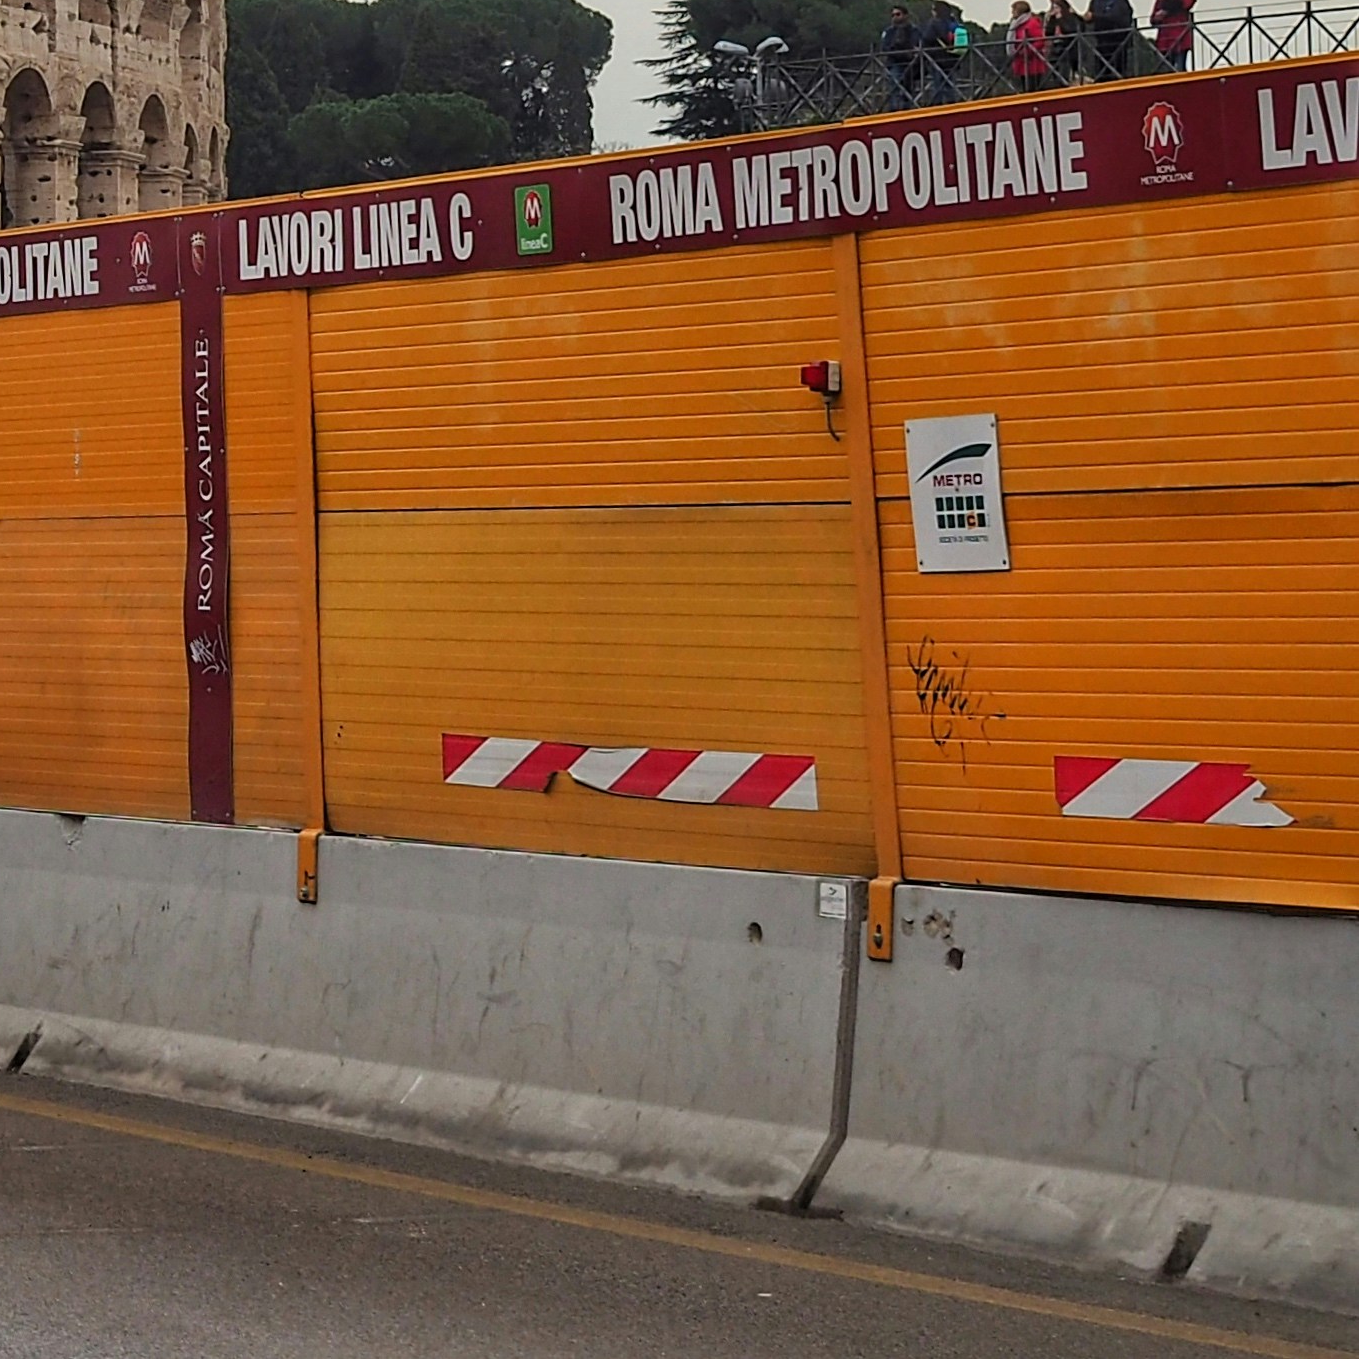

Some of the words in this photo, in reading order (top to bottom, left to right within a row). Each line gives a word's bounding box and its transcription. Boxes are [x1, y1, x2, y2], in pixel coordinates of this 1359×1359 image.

[609, 161, 723, 245] ROMA
[732, 111, 1088, 230] METROPOLITANE
[238, 208, 344, 281] LAVORI
[352, 197, 442, 270] LINEA
[449, 192, 473, 261] C
[195, 337, 213, 502] CAPITALE
[933, 473, 983, 488] METRO
[966, 514, 977, 527] C
[197, 509, 214, 611] ROMA
